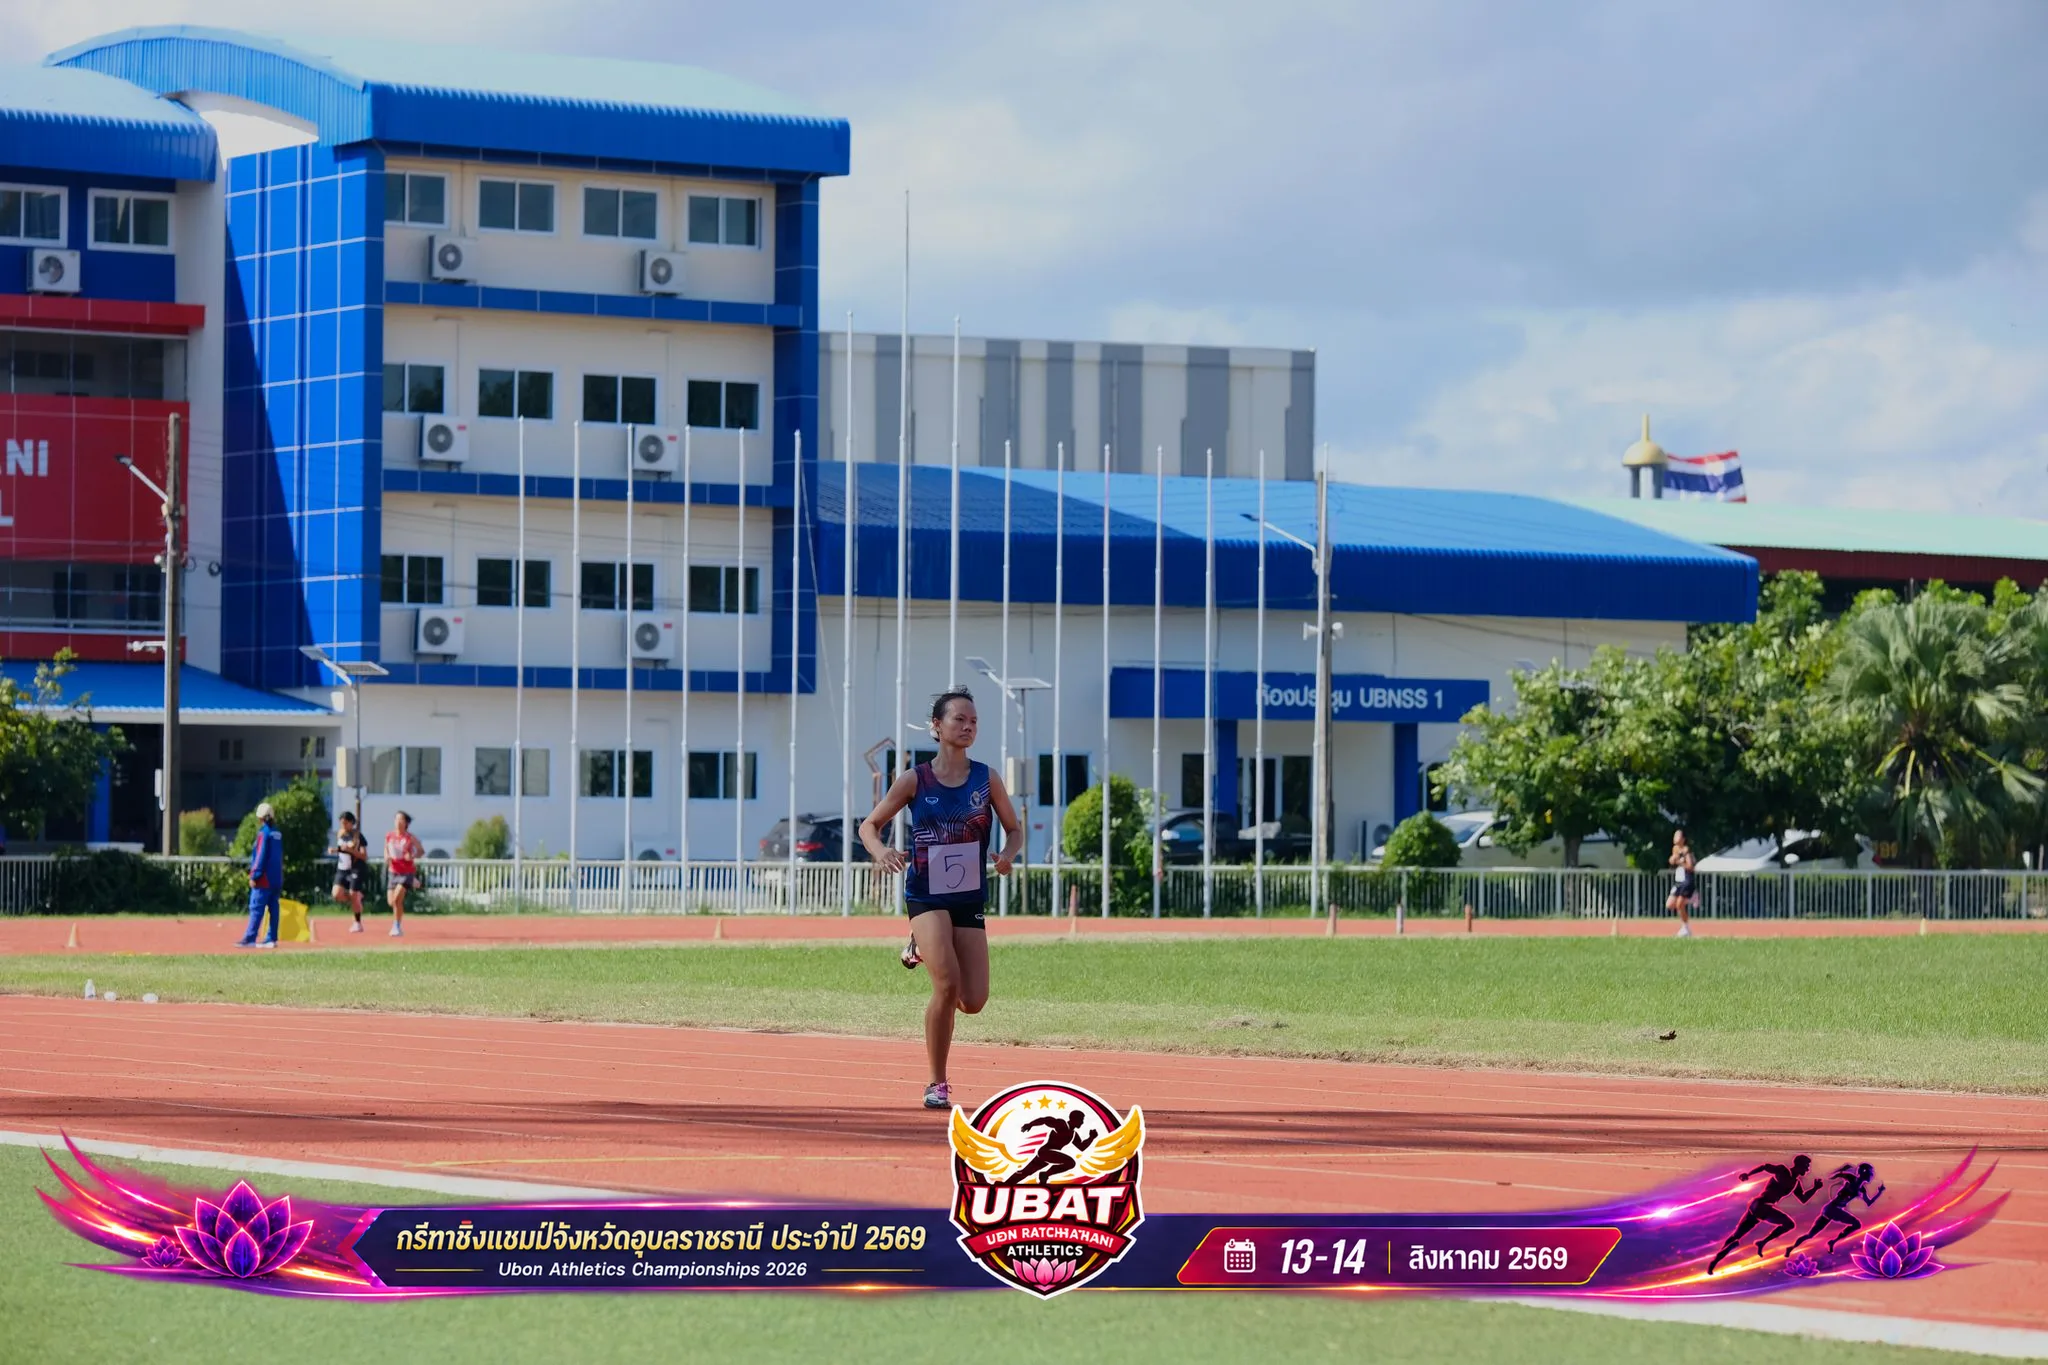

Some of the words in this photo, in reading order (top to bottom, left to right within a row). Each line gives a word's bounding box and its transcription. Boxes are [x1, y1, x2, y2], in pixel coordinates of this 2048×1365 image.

[0, 439, 48, 476] NI
[1360, 687, 1429, 709] UBNSS
[1434, 689, 1443, 709] 1
[944, 854, 966, 889] 5
